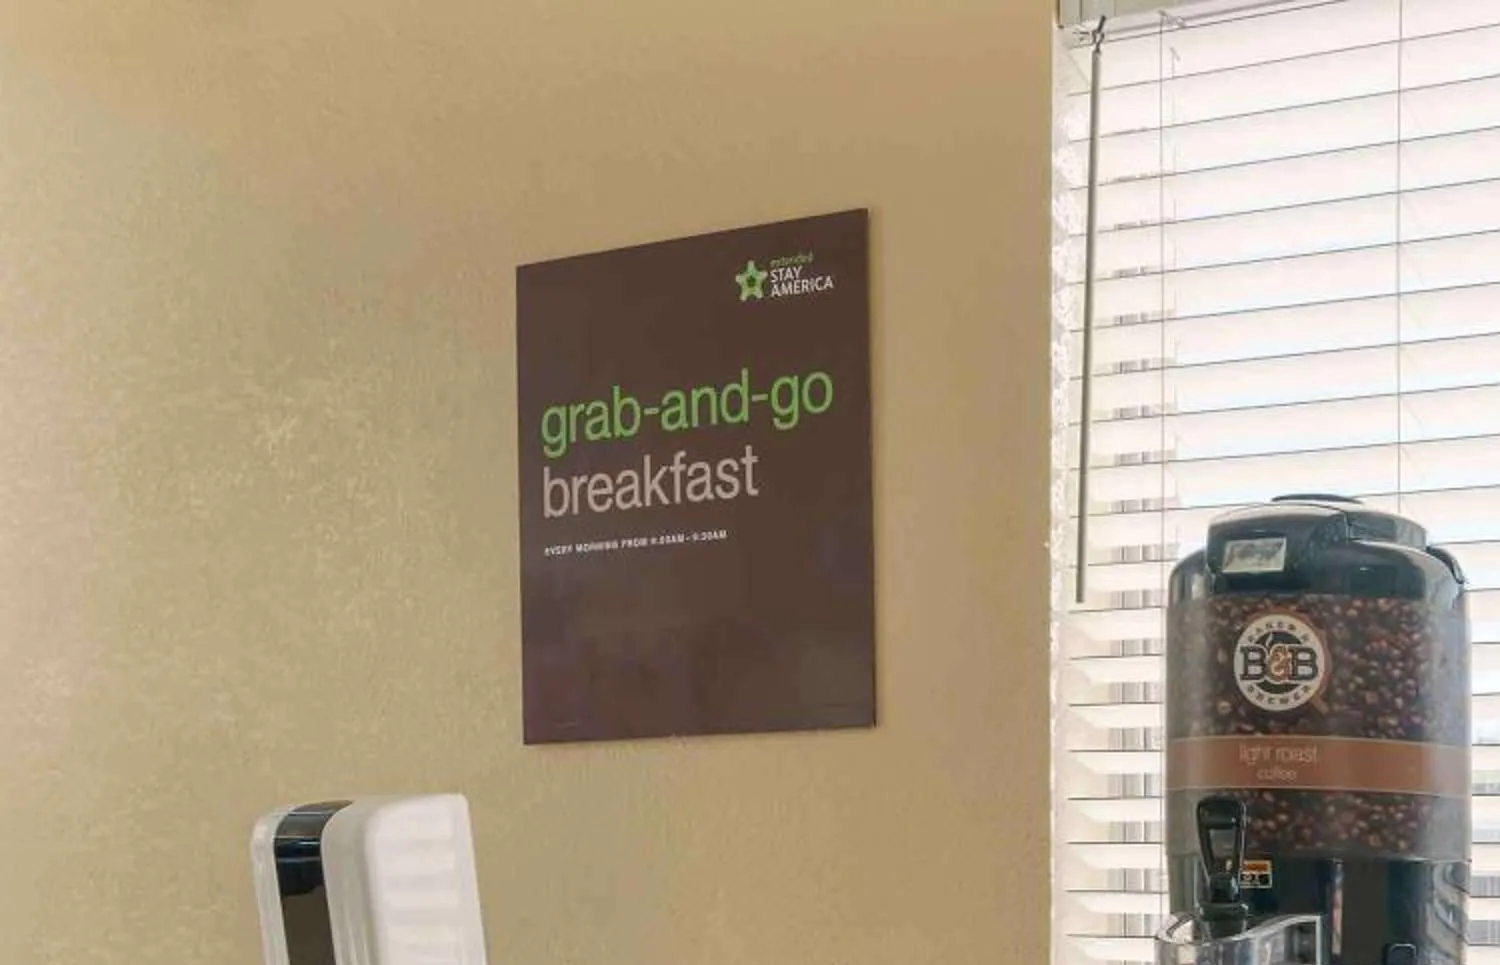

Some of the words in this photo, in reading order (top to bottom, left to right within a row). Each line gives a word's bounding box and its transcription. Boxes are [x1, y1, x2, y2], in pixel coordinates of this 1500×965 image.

[770, 266, 803, 283] STAY
[771, 275, 834, 297] AMERICA
[541, 367, 834, 458] grab-and-go
[543, 445, 759, 518] breakfast
[1275, 745, 1318, 763] roast
